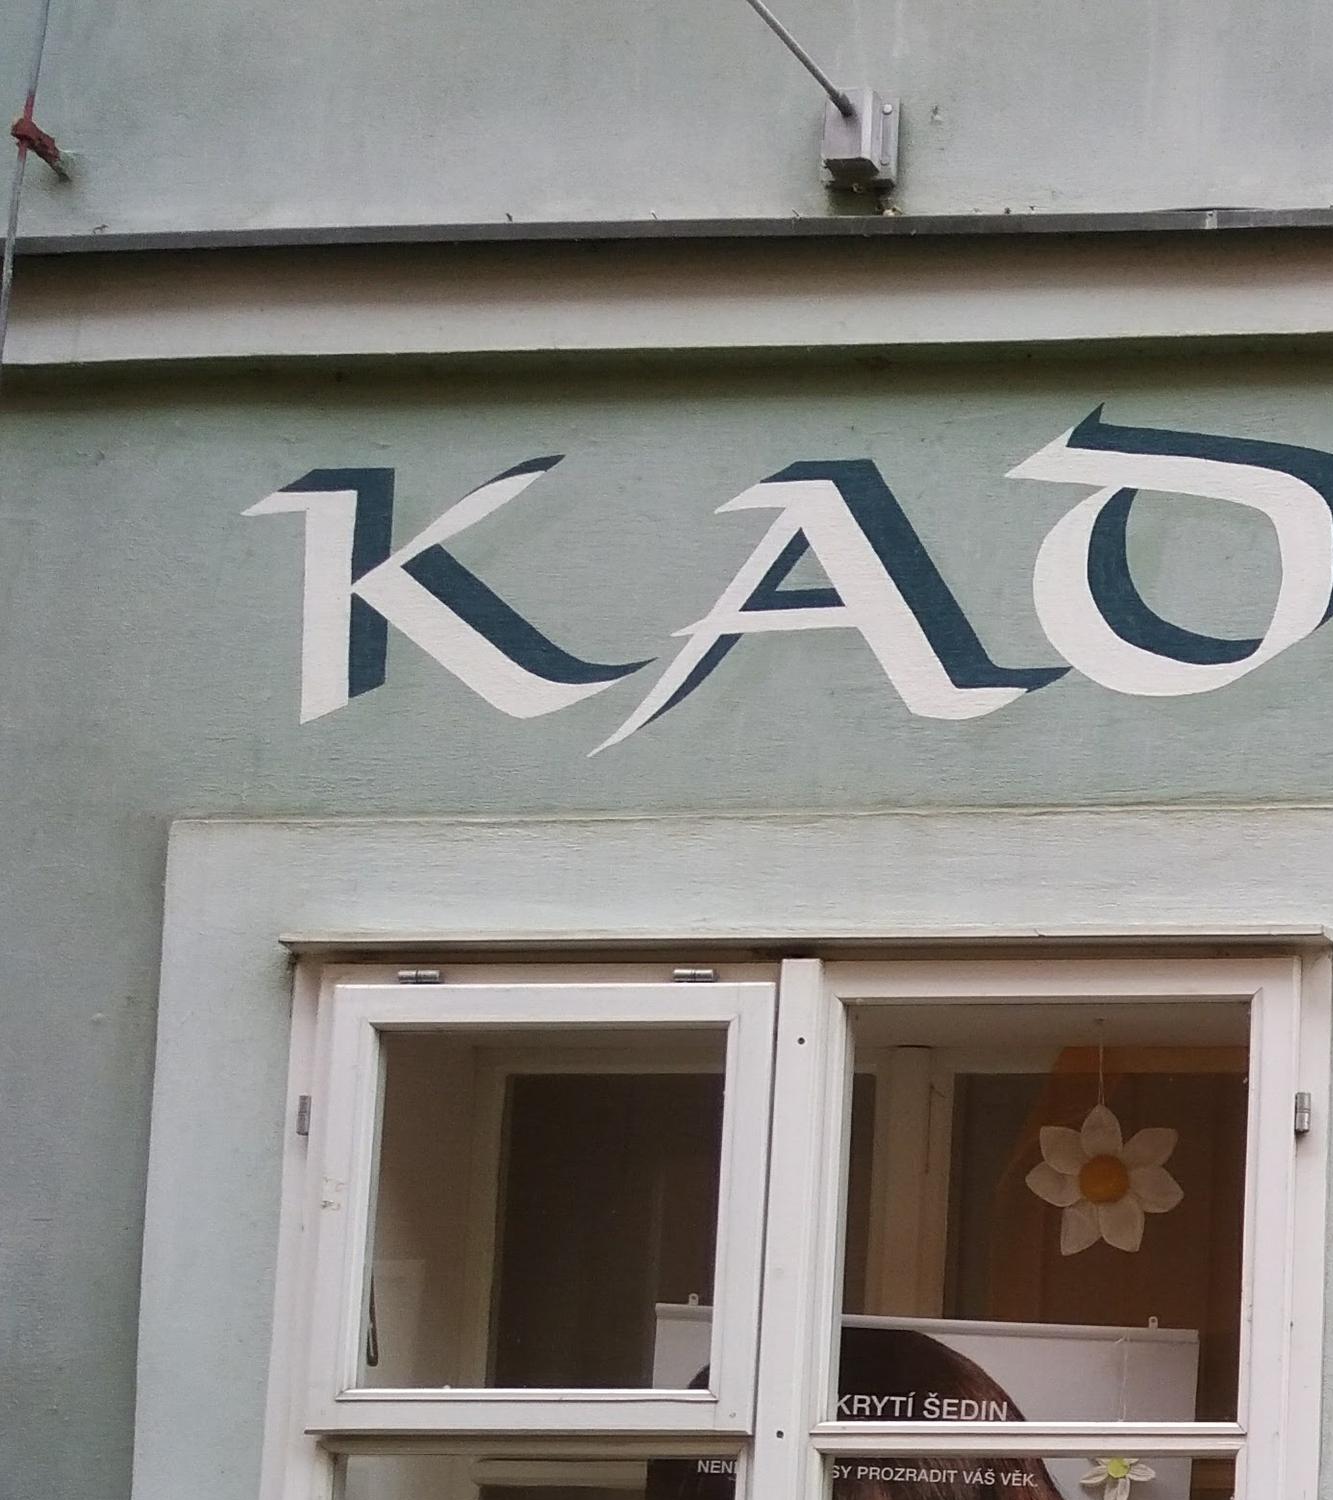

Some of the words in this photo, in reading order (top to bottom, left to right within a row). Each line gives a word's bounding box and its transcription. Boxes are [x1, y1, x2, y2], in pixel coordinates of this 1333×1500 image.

[836, 1391, 915, 1418] KRYTÍ
[922, 1392, 1008, 1422] ŠEDIN
[857, 1466, 958, 1484] PROZRADIT
[963, 1467, 996, 1486] VÁŠ
